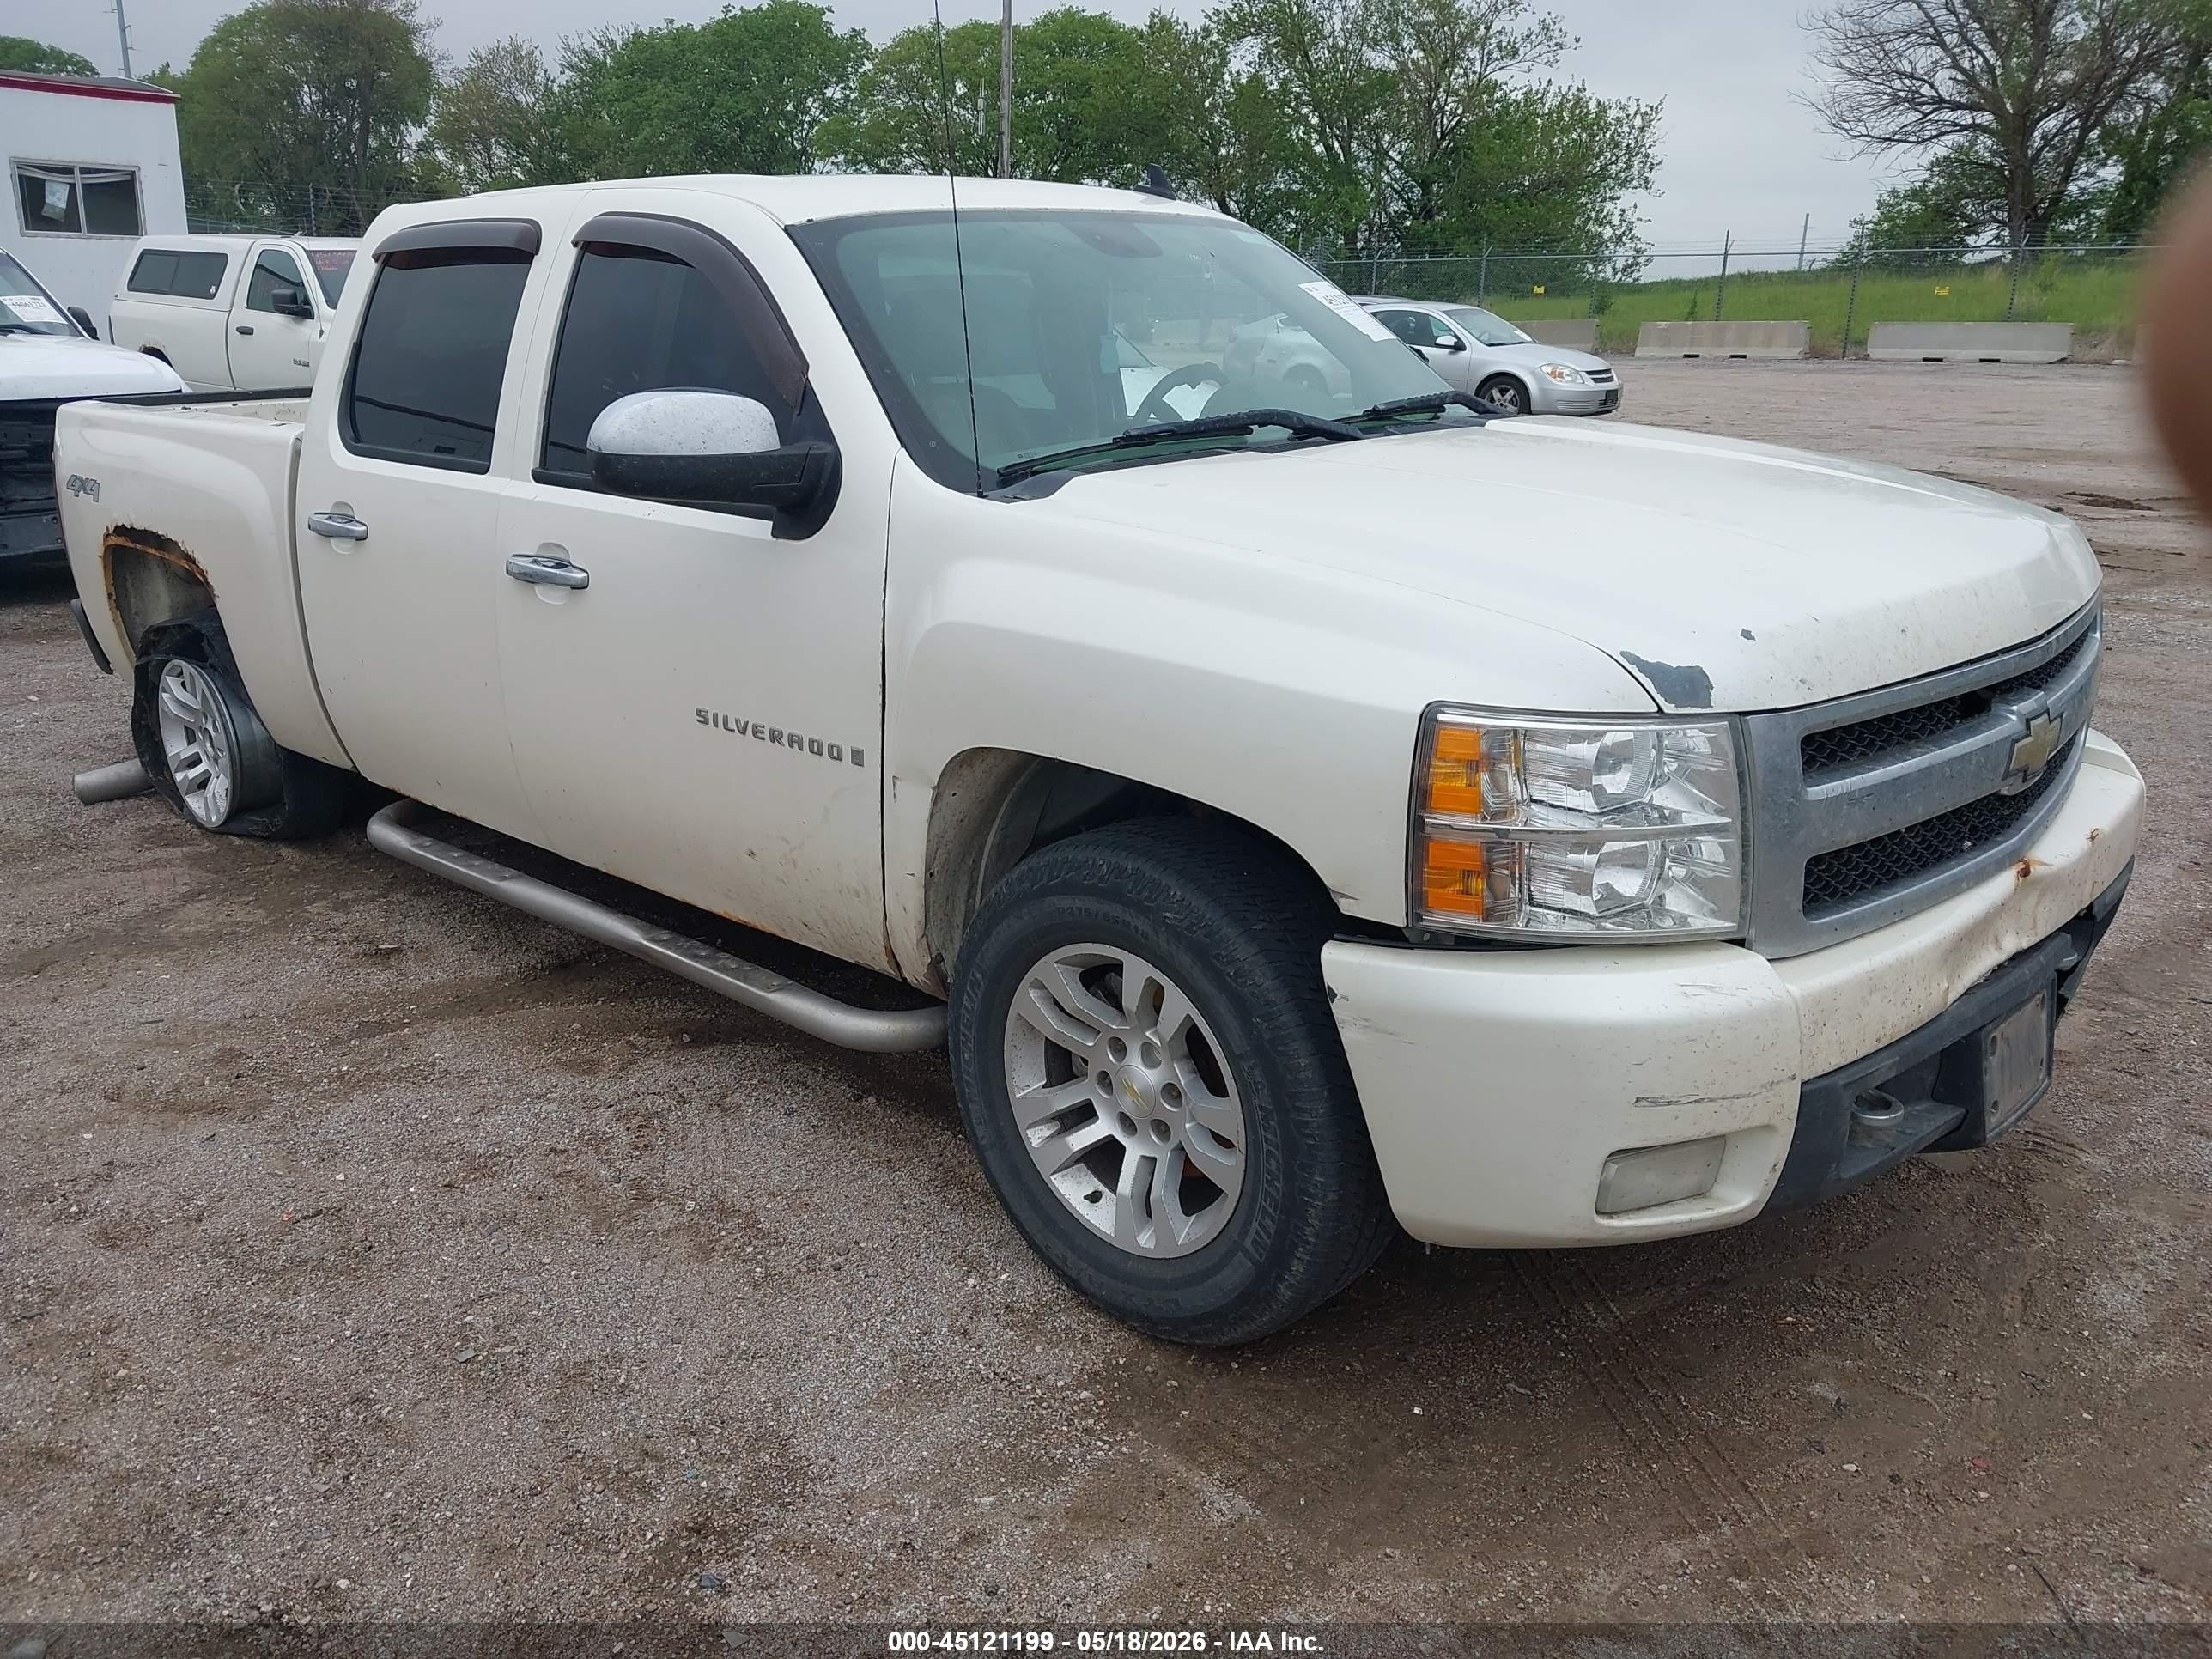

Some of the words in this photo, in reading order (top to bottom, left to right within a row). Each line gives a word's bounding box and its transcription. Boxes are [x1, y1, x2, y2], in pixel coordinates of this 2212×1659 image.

[695, 707, 844, 763] SILVERADO
[960, 968, 986, 1101] MICHELIN
[1249, 1104, 1283, 1264] MICHELIN
